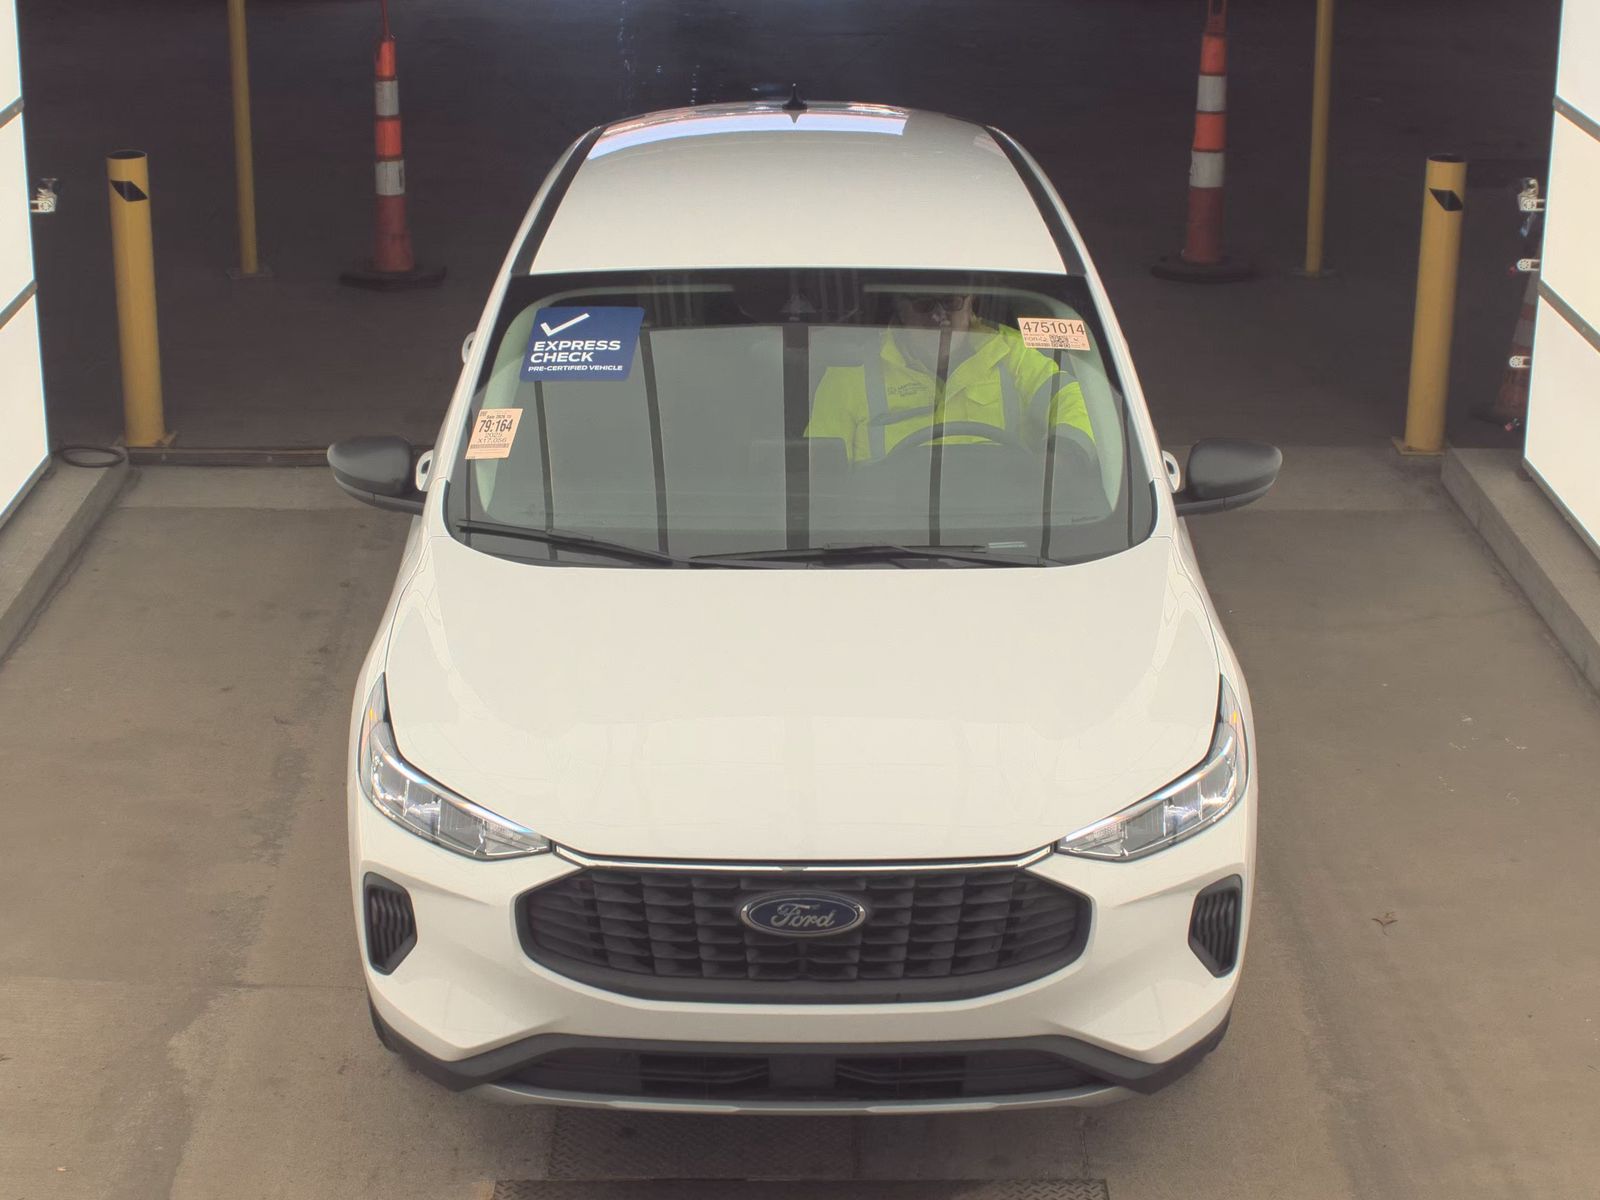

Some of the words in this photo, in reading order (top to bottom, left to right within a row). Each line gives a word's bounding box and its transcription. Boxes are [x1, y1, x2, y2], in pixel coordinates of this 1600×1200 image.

[1023, 321, 1085, 335] 4751014
[533, 340, 621, 352] EXPRESS
[530, 352, 594, 363] CHECK
[528, 364, 588, 372] PRE-CERTIFIED
[479, 418, 514, 433] 79:164
[770, 902, 838, 928] Ford
